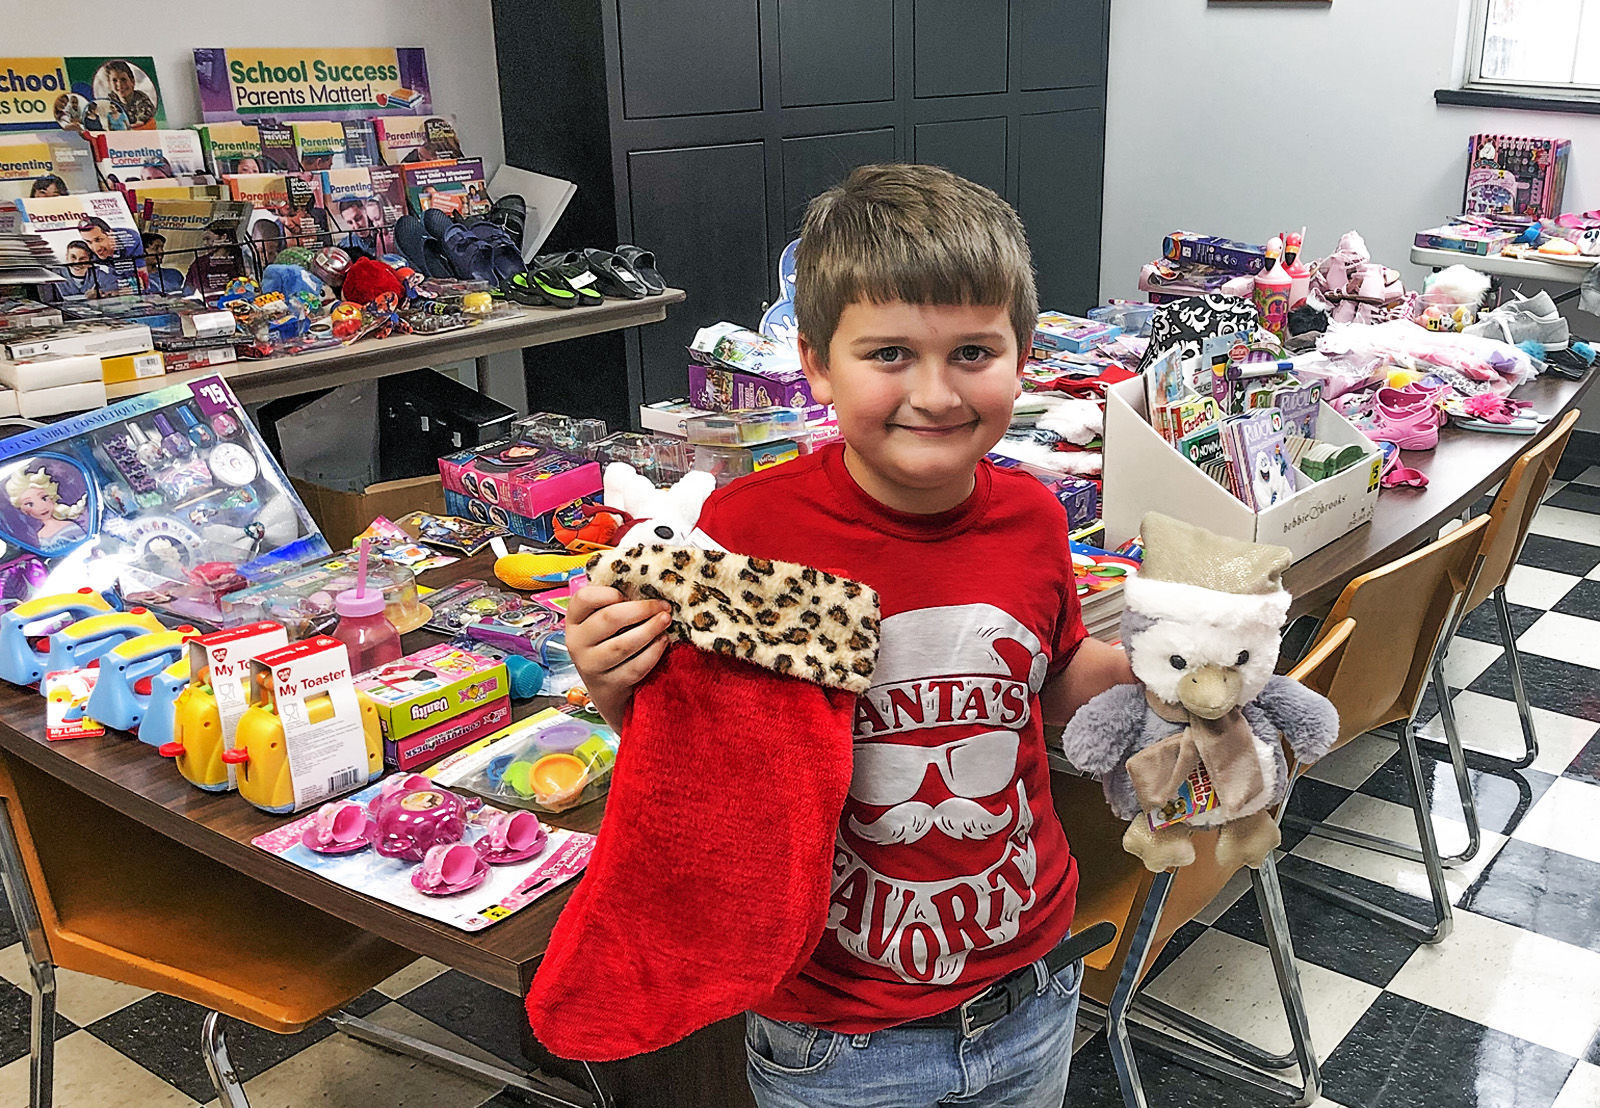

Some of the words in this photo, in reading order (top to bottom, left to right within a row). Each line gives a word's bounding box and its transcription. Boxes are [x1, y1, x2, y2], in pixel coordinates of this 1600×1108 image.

[0, 67, 66, 93] chool
[229, 59, 308, 84] School
[315, 59, 398, 82] Success
[236, 86, 306, 106] Parents
[309, 83, 373, 104] Matter!
[16, 97, 47, 115] too
[300, 137, 346, 147] Parenting
[386, 130, 427, 141] Parenting
[109, 147, 163, 158] Parenting
[211, 140, 261, 152] Parenting
[240, 191, 288, 201] Parenting
[330, 183, 373, 194] Parenting
[29, 211, 90, 223] Parenting
[152, 214, 210, 224] Parenting
[15, 422, 73, 448] ENSEMBLE
[1244, 421, 1272, 444] RUDOL
[215, 664, 234, 676] My
[279, 684, 297, 696] My
[301, 669, 346, 690] Toaster
[411, 697, 449, 721] Vanity
[853, 680, 1025, 737] ANTA'S
[433, 720, 481, 746] COMPUTER
[404, 742, 429, 760] DESK
[829, 840, 1031, 981] FAVORIT
